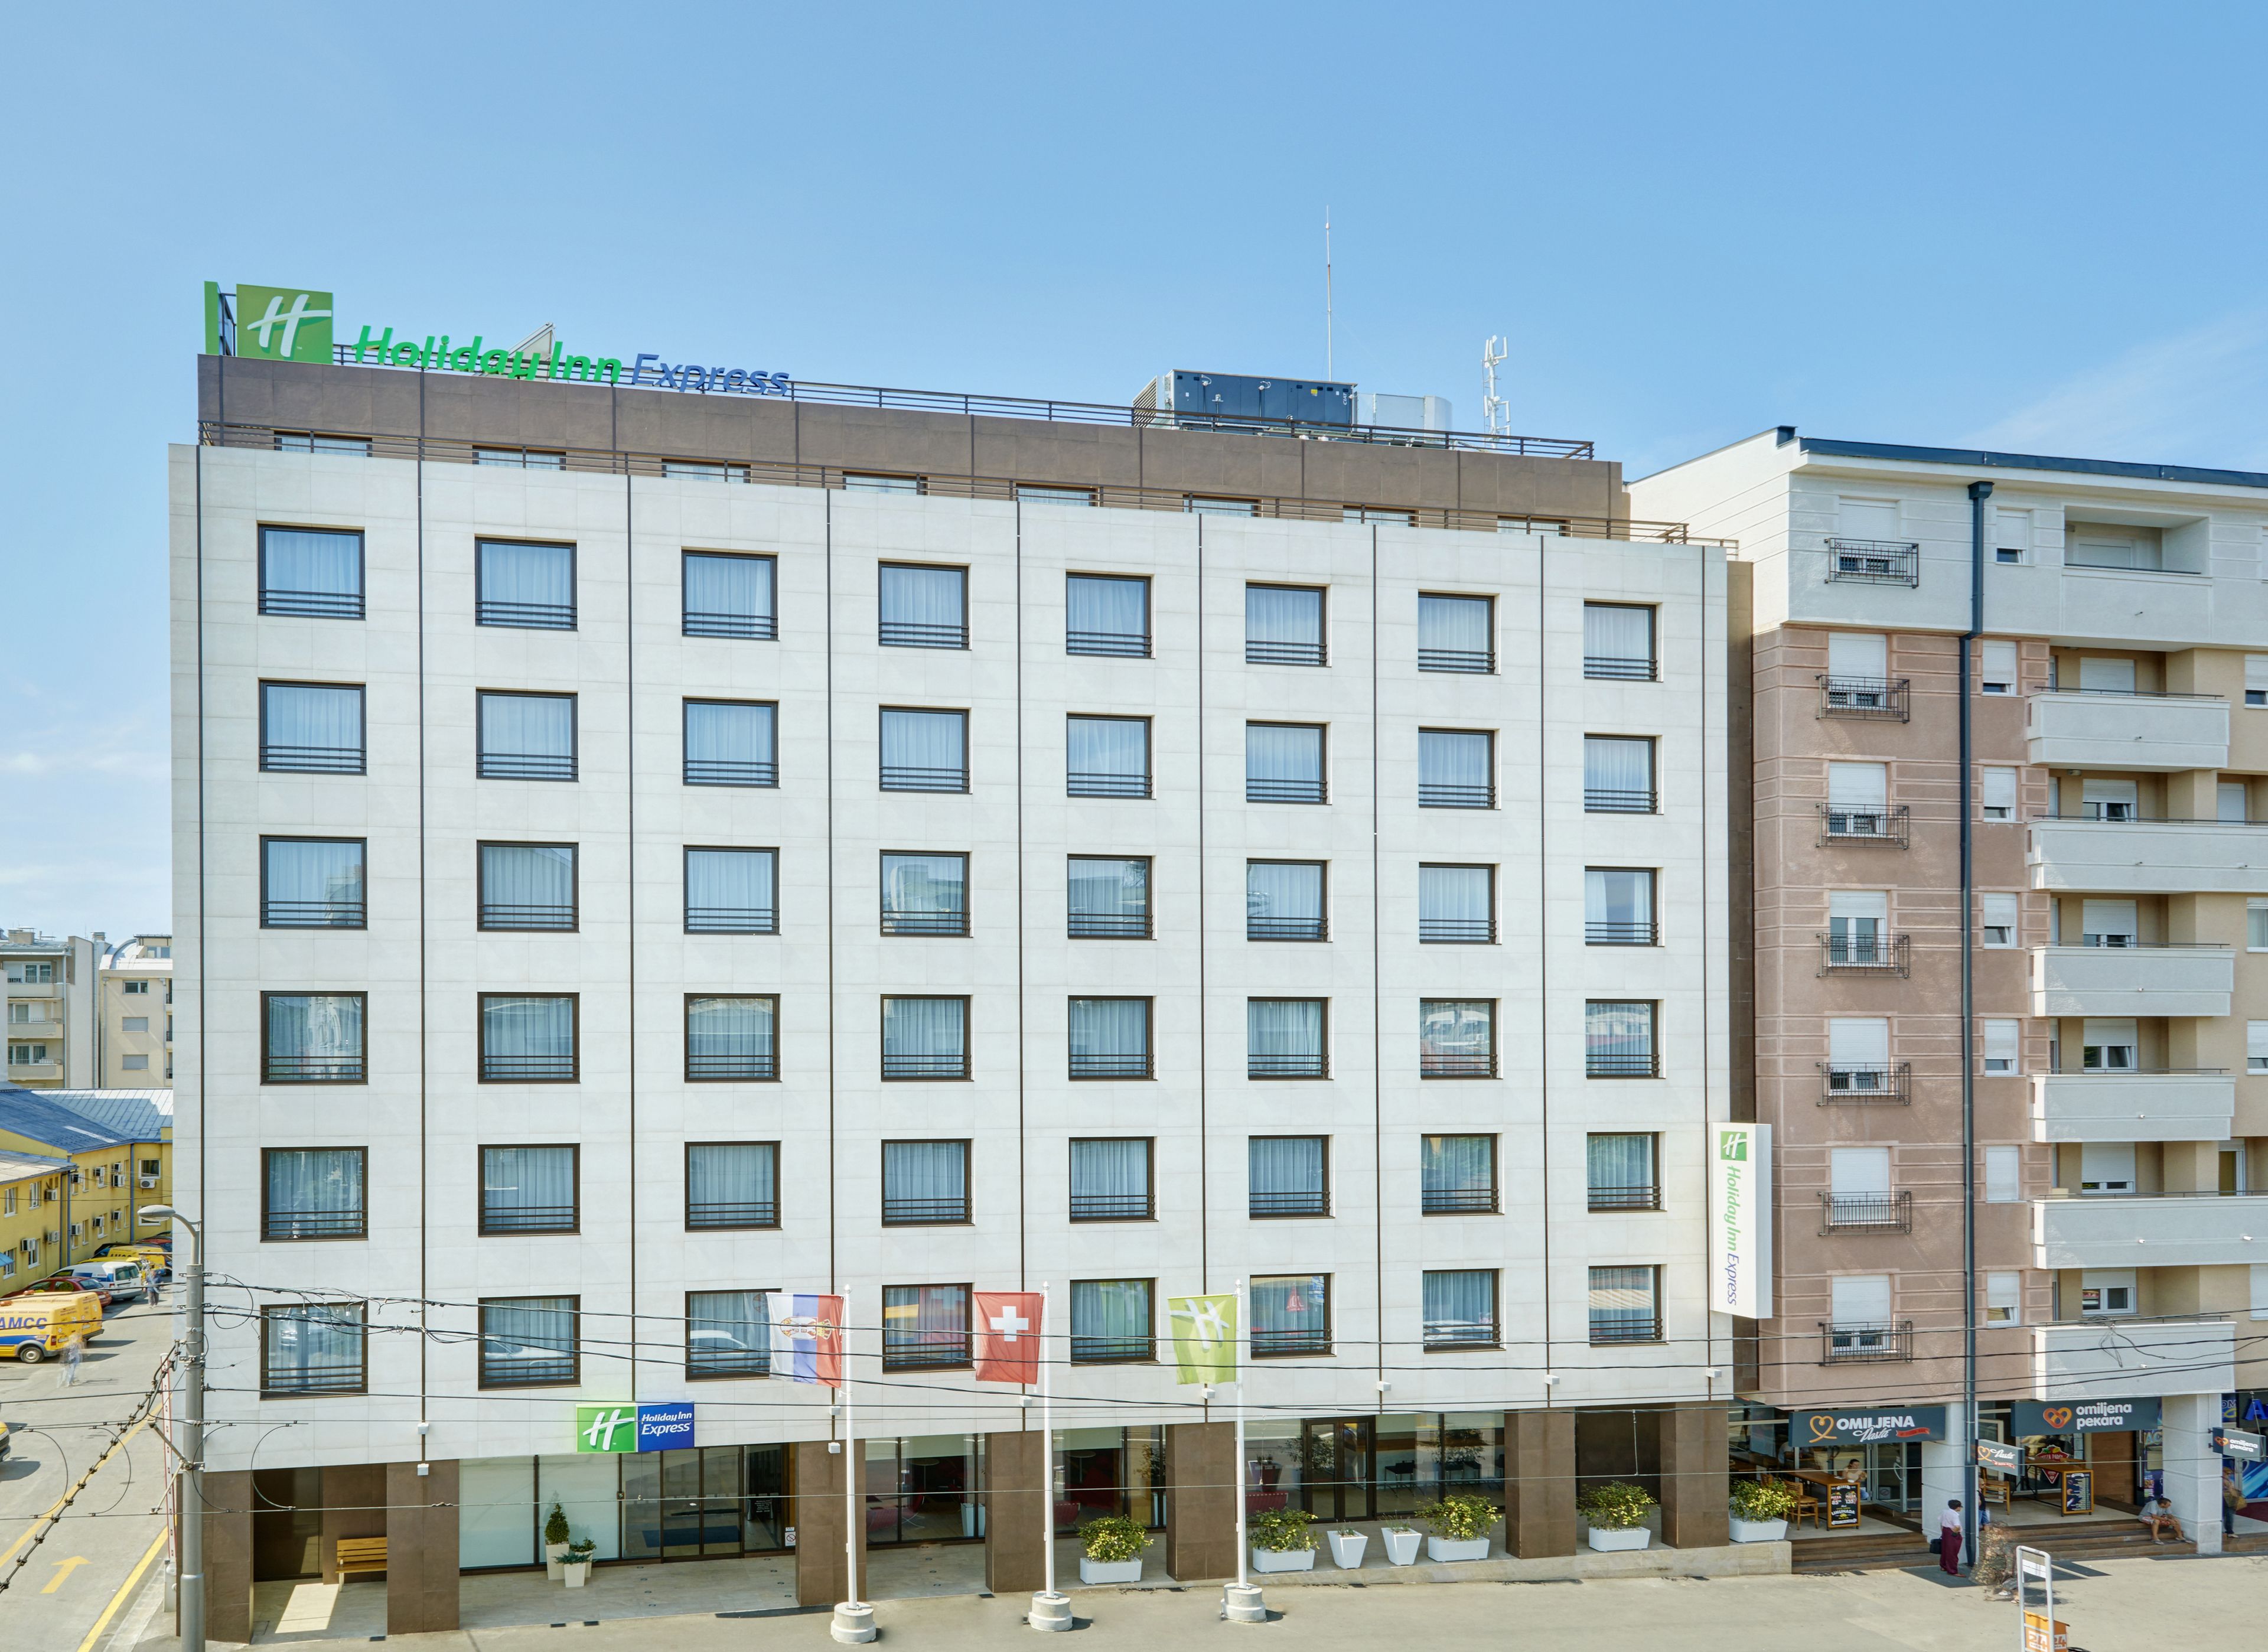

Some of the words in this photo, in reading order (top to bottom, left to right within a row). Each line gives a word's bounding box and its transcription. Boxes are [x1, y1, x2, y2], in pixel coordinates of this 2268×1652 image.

[351, 325, 542, 382] Holiday
[549, 341, 622, 384] Inn
[631, 353, 790, 396] Express
[1724, 1165, 1741, 1226] Holiday
[1727, 1226, 1741, 1251] Inn
[1725, 1253, 1739, 1305] Express
[2076, 1402, 2132, 1416] omiljena
[641, 1413, 677, 1422] Holiday
[1836, 1416, 1915, 1430] OMILJENA
[2077, 1416, 2123, 1430] pekara
[641, 1422, 690, 1436] Express
[1853, 1425, 1892, 1442] Pasta
[2230, 1439, 2258, 1449] omiljena
